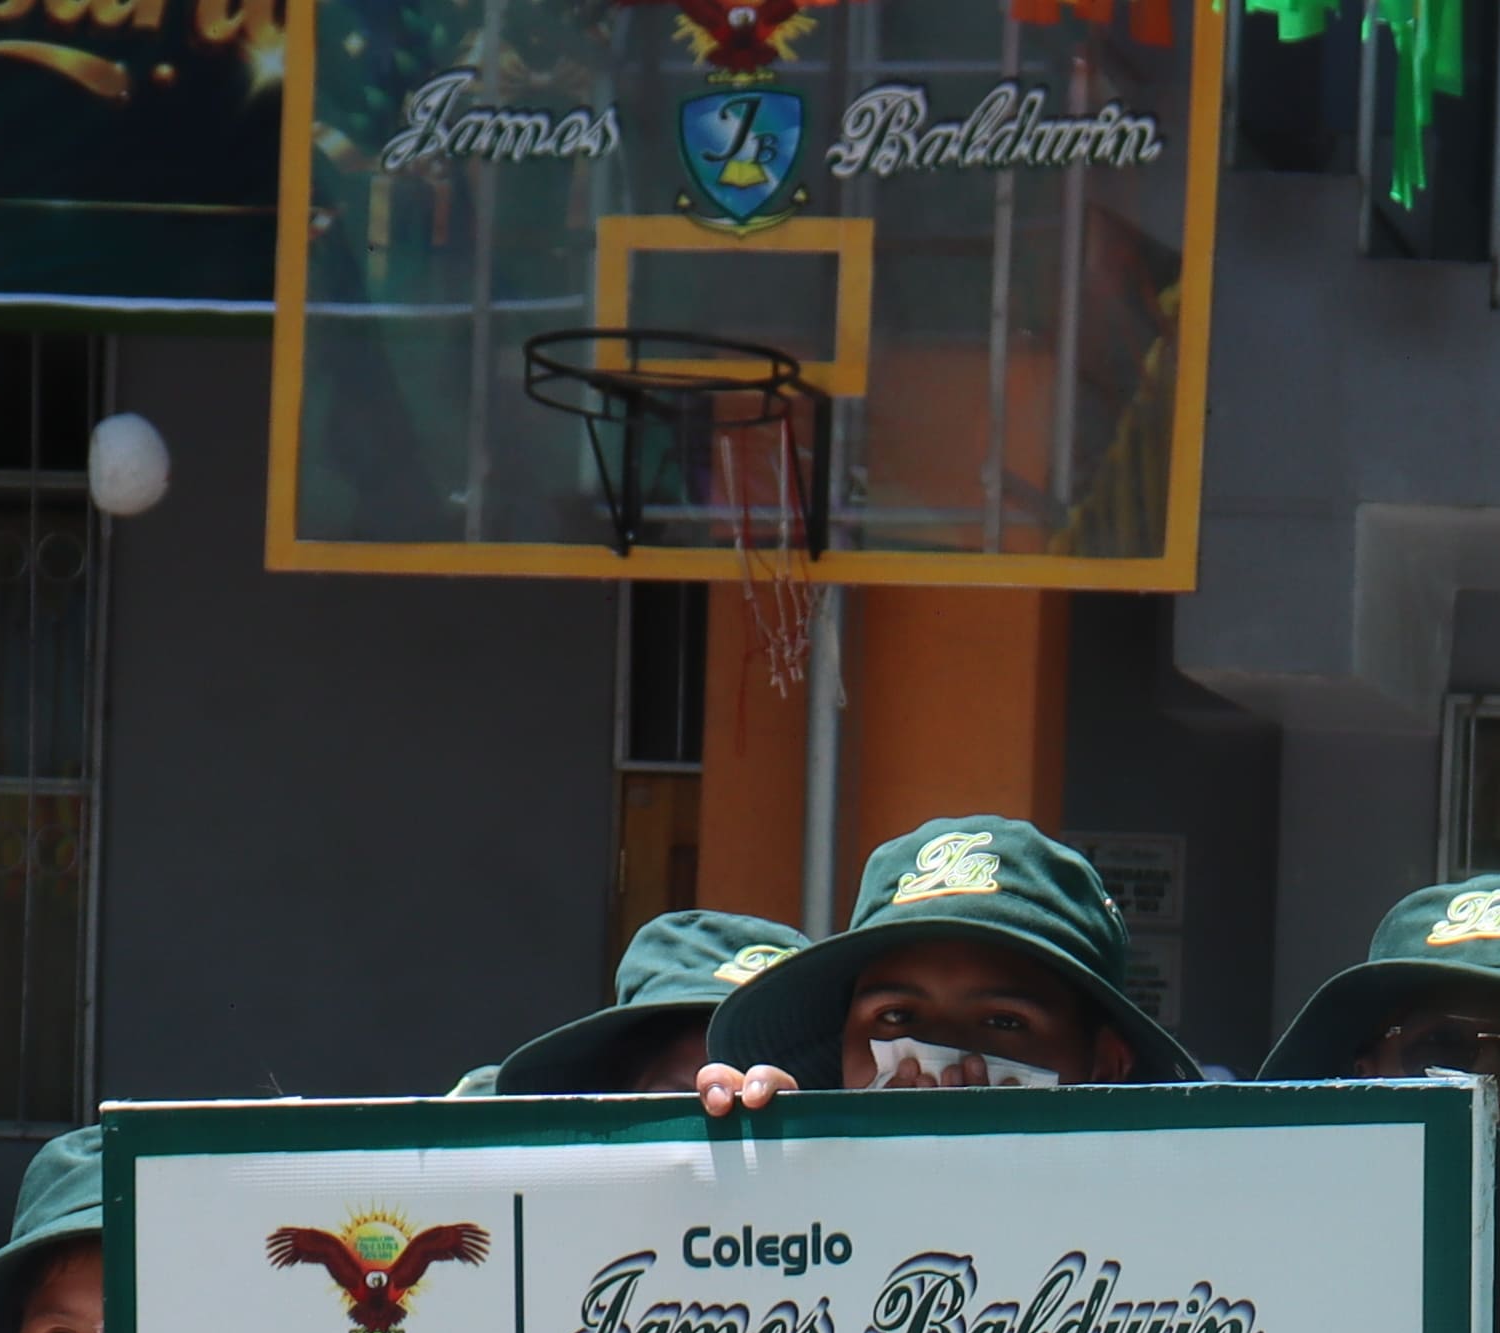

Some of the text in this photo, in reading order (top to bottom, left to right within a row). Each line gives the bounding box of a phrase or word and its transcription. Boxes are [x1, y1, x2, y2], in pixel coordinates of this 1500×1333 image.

[381, 66, 1164, 178] James Baldwin
[682, 1222, 853, 1276] Colegio
